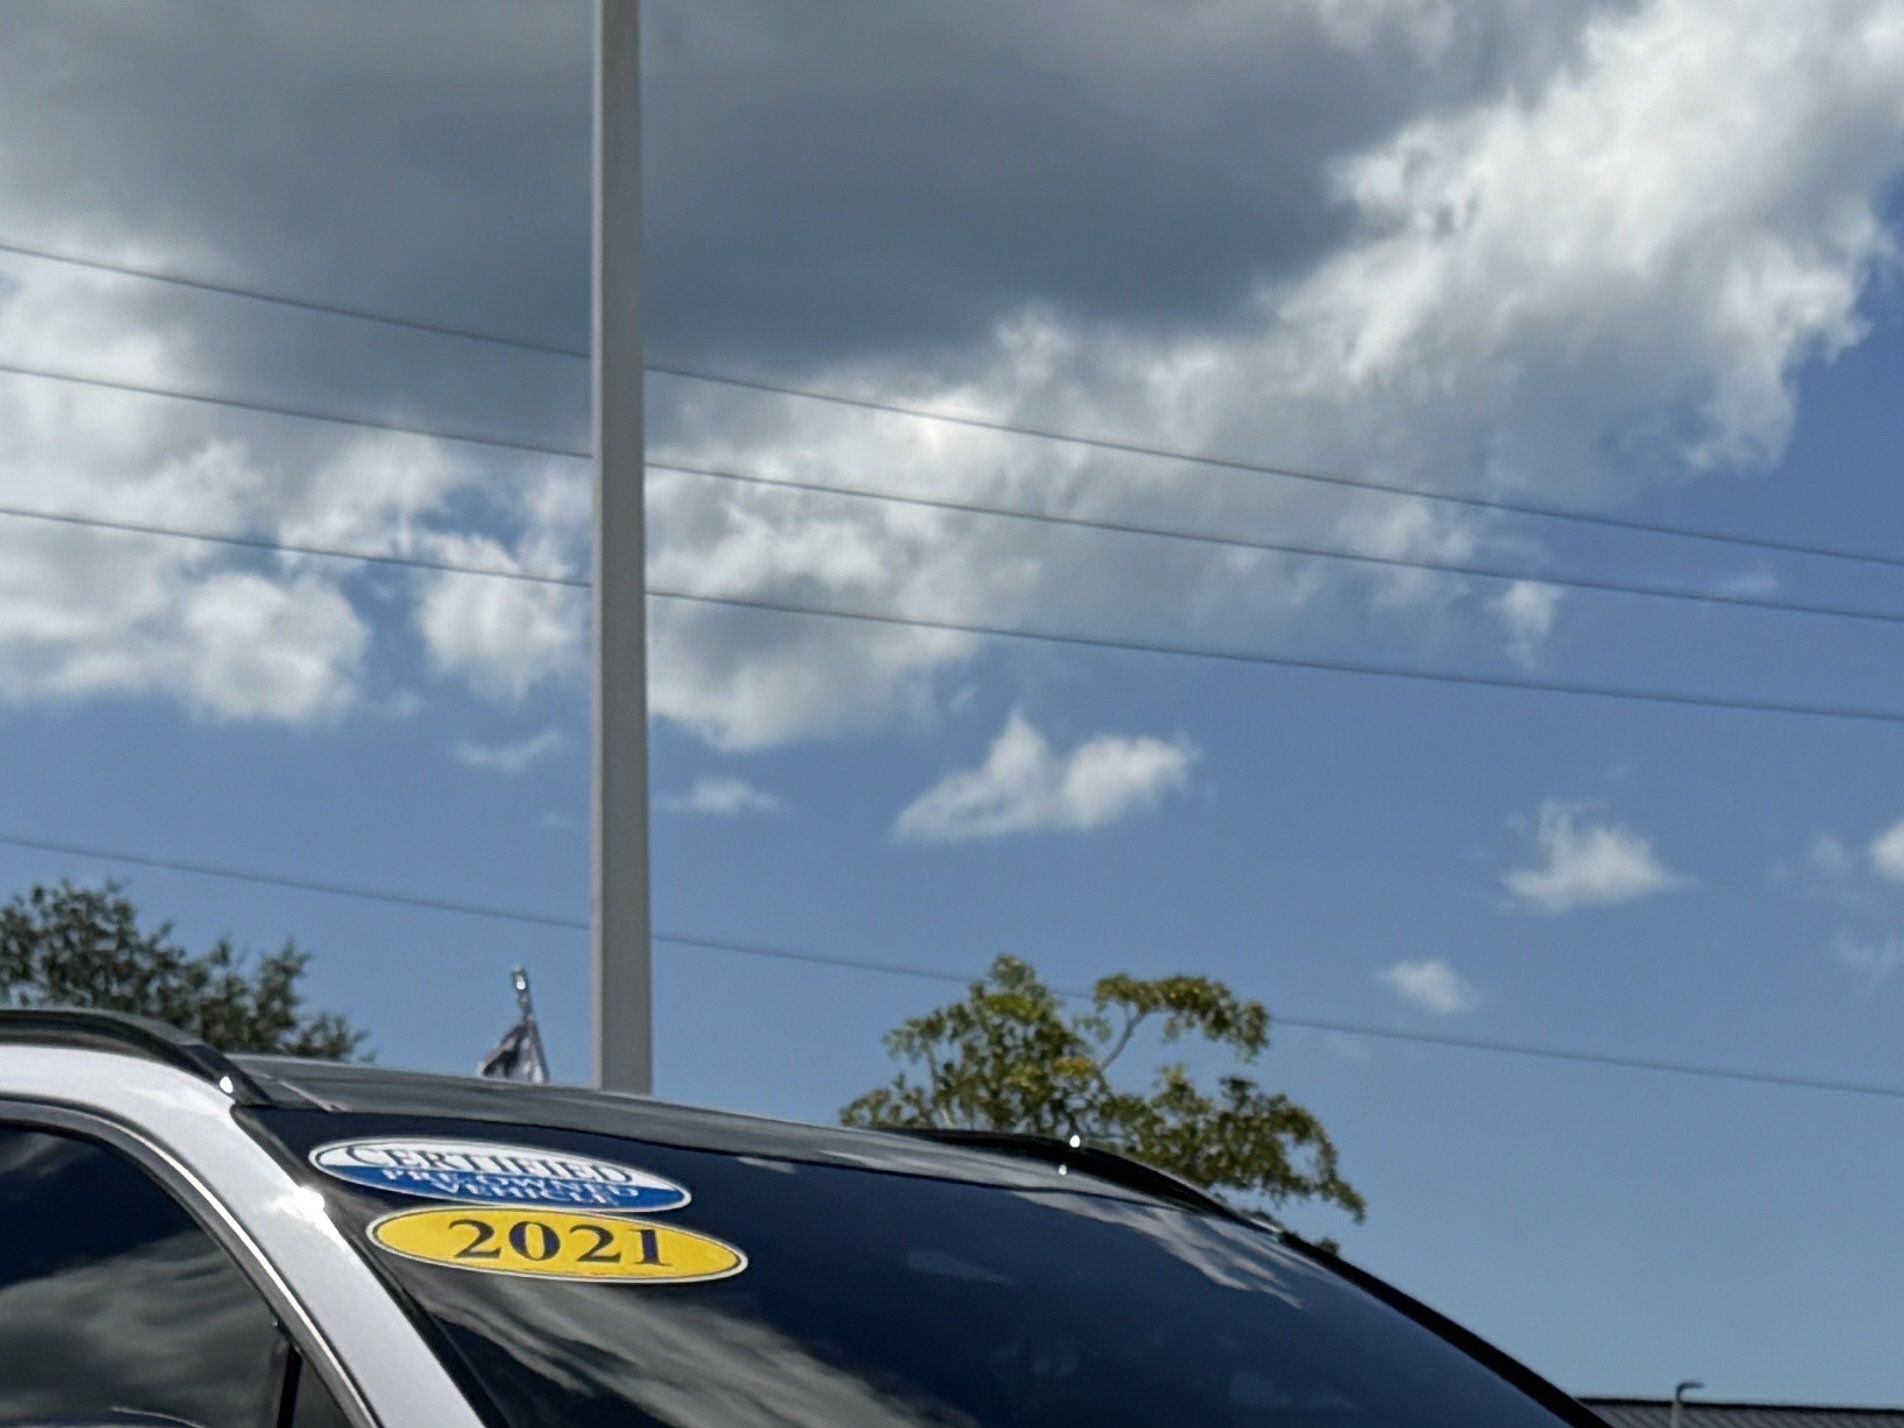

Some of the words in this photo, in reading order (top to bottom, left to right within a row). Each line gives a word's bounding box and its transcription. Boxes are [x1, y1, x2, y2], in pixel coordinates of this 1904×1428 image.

[346, 1147, 632, 1183] CERTIFIED
[431, 1176, 619, 1205] VEHICLE
[448, 1219, 673, 1267] 2021
